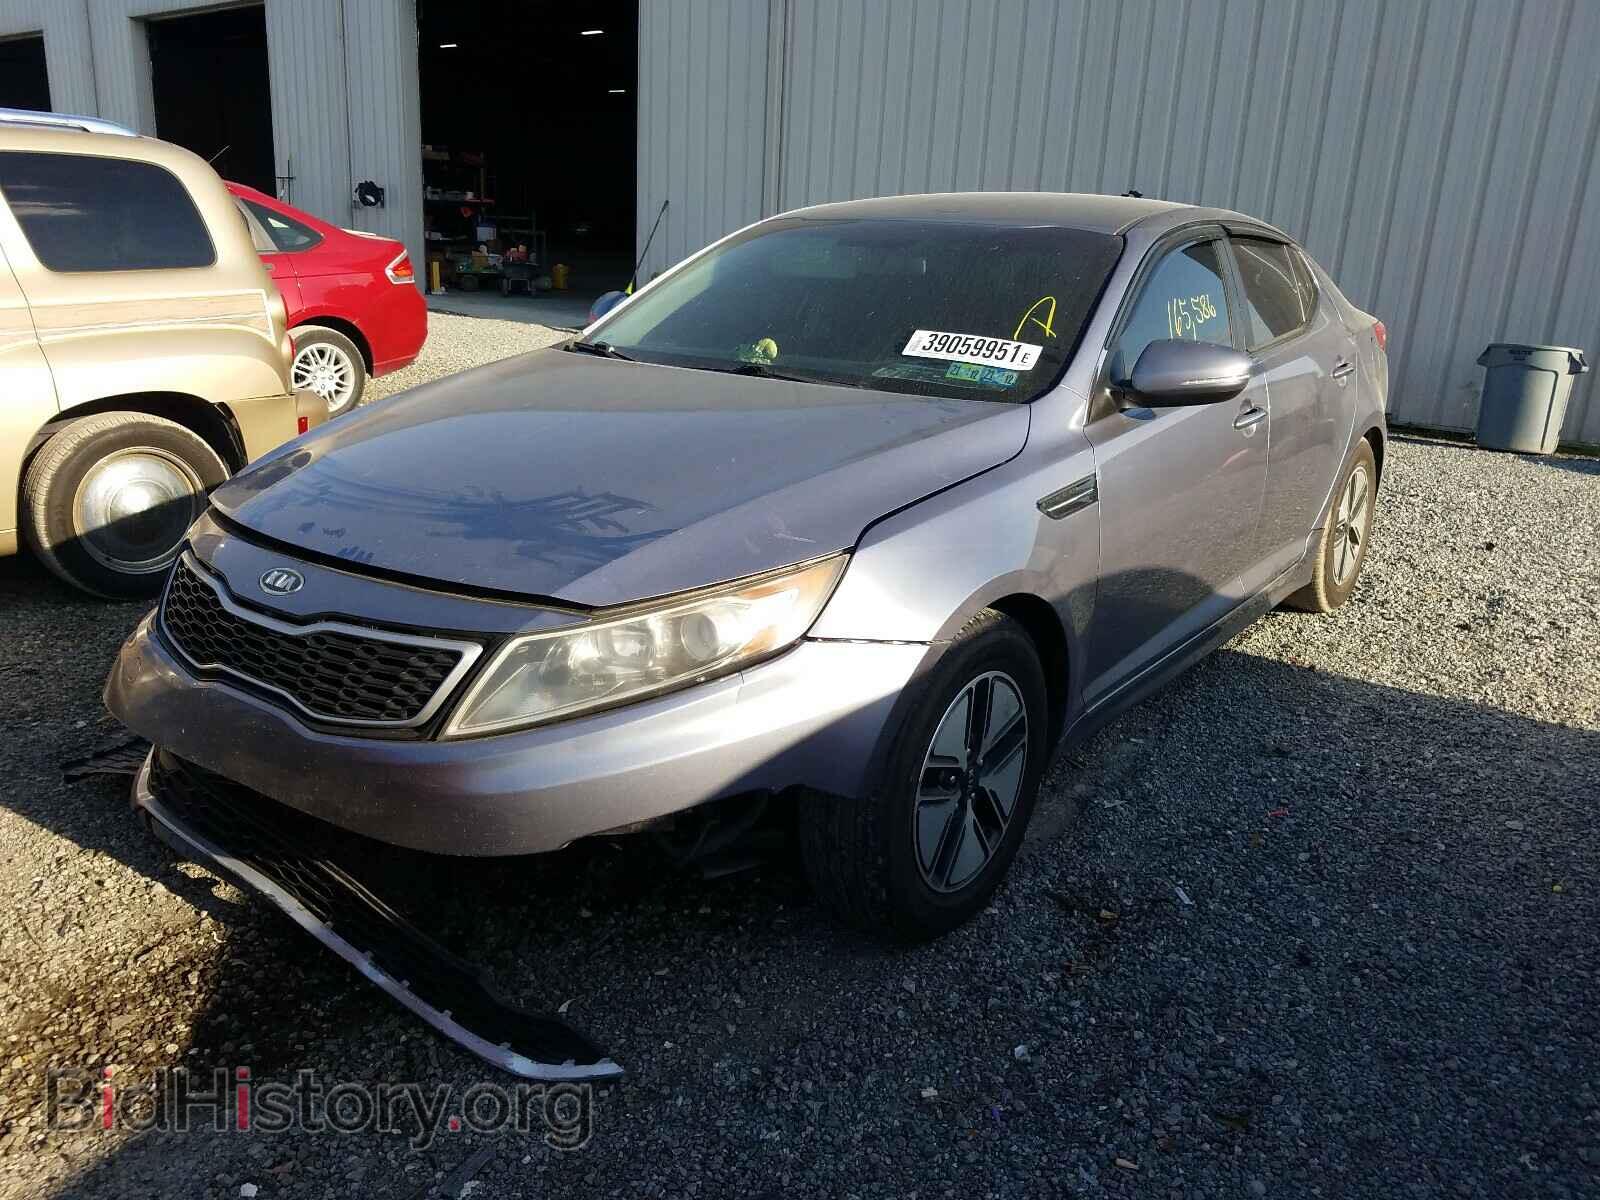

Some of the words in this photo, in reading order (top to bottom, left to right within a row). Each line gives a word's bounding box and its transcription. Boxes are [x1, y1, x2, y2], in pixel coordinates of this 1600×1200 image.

[1013, 296, 1057, 341] A
[922, 333, 1022, 363] 39059951
[1021, 352, 1031, 364] E
